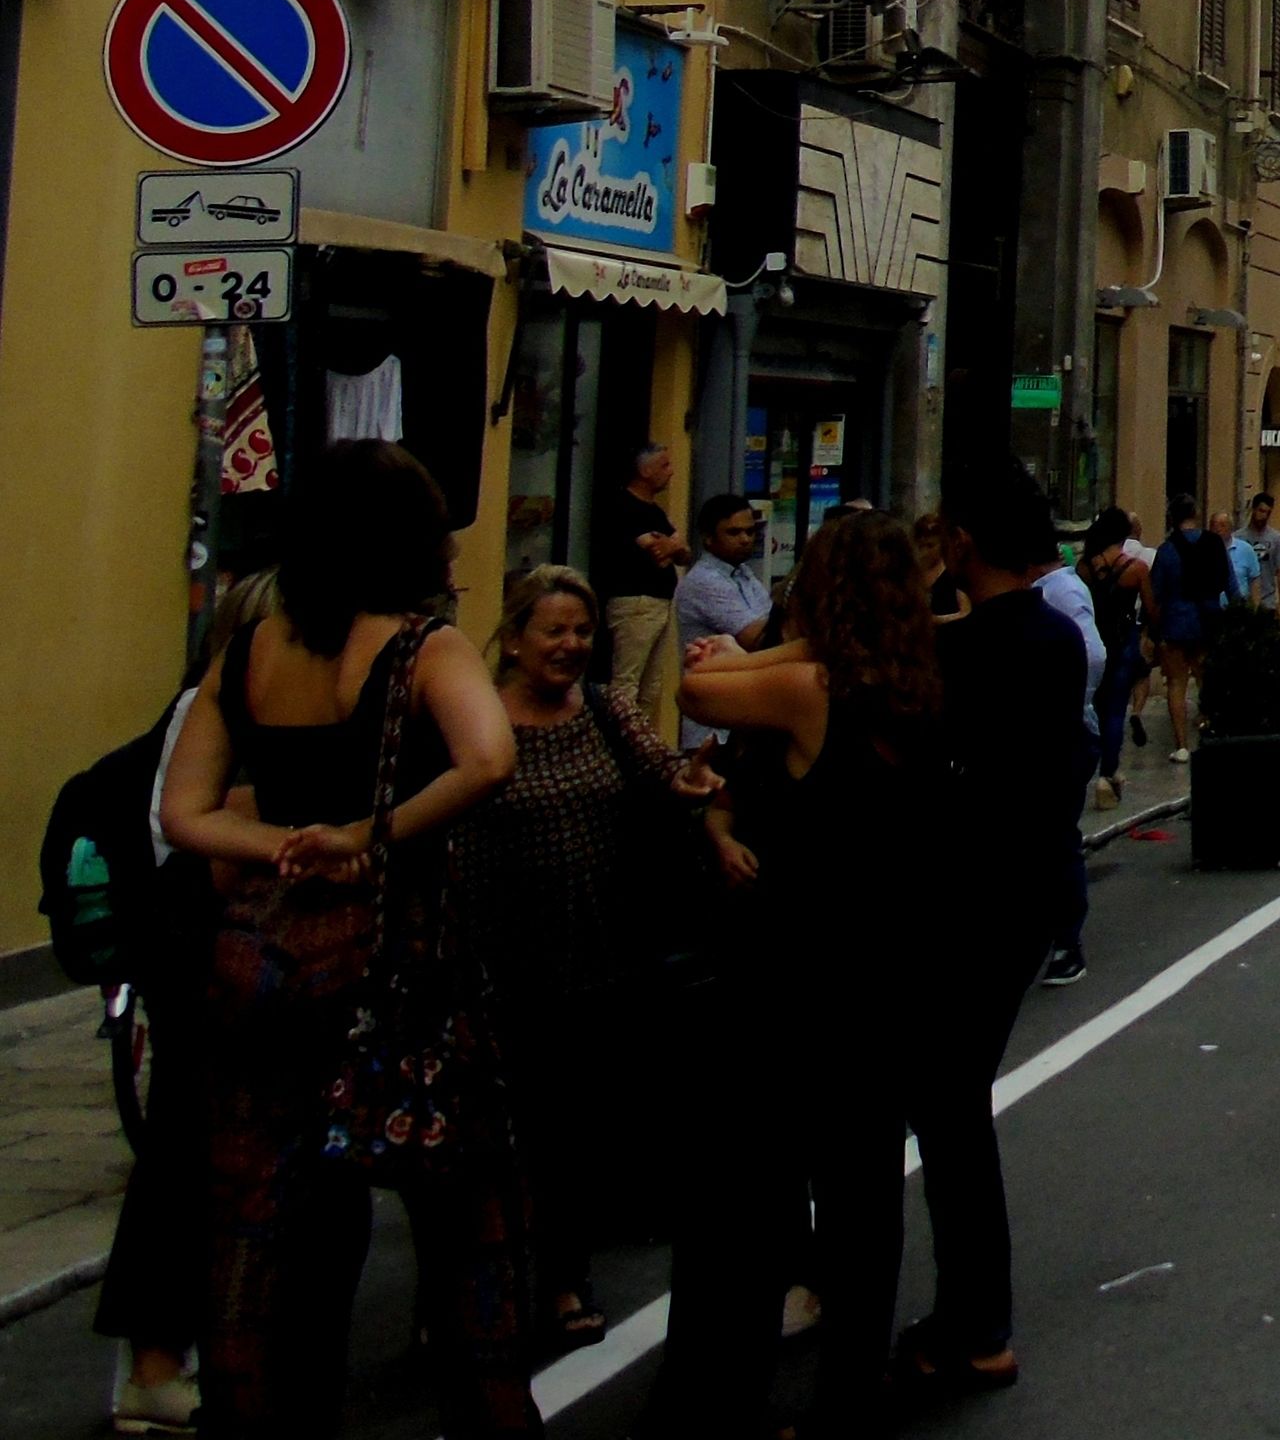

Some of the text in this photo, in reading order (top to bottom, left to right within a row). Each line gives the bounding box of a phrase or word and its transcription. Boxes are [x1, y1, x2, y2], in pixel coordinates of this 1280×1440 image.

[542, 150, 654, 223] La Caramella
[152, 274, 177, 303] 0
[221, 271, 271, 300] 24
